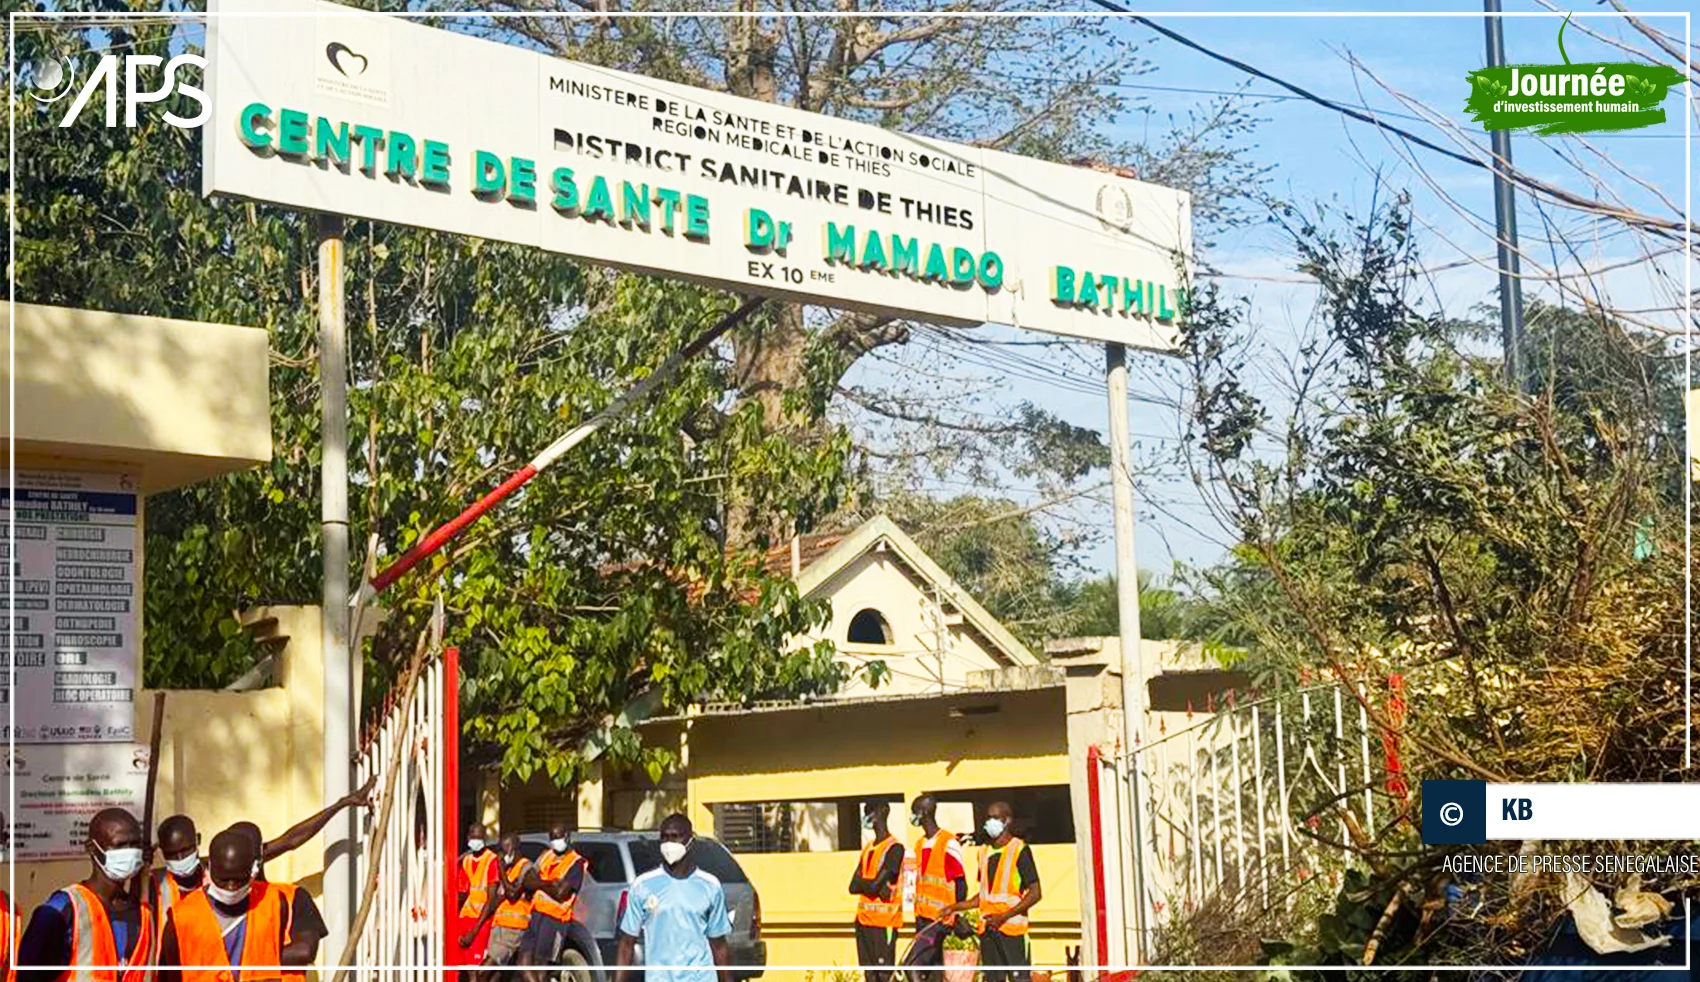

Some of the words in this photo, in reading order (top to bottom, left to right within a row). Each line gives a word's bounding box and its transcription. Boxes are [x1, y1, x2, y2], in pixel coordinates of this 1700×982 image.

[549, 75, 649, 111] MINISTERE
[655, 98, 679, 117] DE
[685, 104, 707, 122] LA
[712, 110, 770, 135] SANTE
[776, 120, 796, 141] ET
[802, 128, 823, 147] DE
[829, 134, 904, 164] L'ACTION
[908, 151, 975, 179] SOCIALE
[553, 127, 692, 174] DISTRICT
[700, 157, 849, 206] SANITAIRE
[858, 187, 892, 215] DE
[900, 196, 975, 231] THIES
[652, 115, 720, 144] REGION
[726, 131, 813, 163] MEDICALE
[818, 150, 840, 167] DE
[845, 155, 891, 178] THIES
[237, 102, 451, 190] CENTRE
[470, 149, 536, 204] DE
[550, 166, 711, 240] SANTE
[744, 207, 792, 253] Dr
[823, 221, 1004, 292] MAMADO
[748, 261, 774, 280] EX
[781, 266, 804, 285] 10
[811, 269, 836, 283] EME
